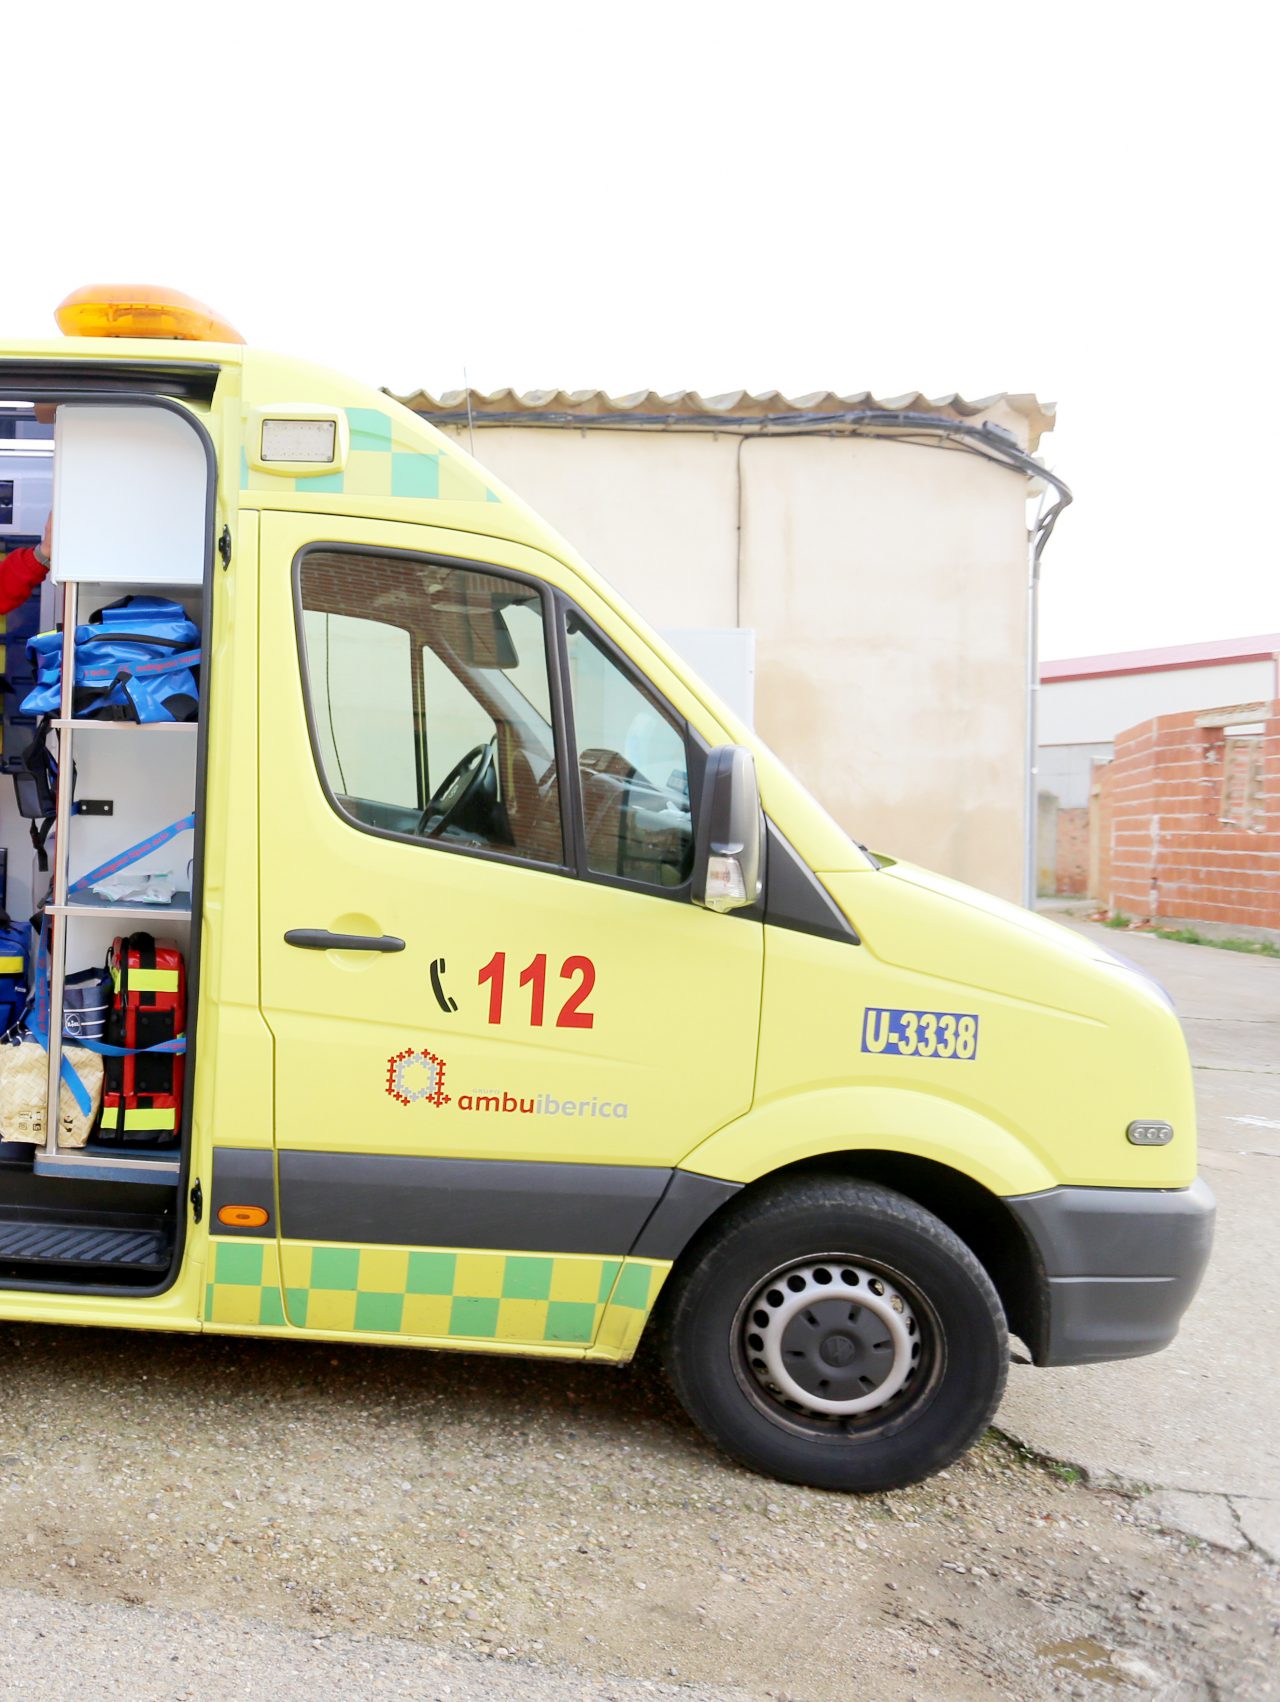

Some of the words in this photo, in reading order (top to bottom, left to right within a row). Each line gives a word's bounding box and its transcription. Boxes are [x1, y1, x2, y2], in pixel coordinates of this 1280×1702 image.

[478, 951, 596, 1029] 112
[866, 1010, 976, 1059] U-3338
[457, 1092, 629, 1119] ambuiberica
